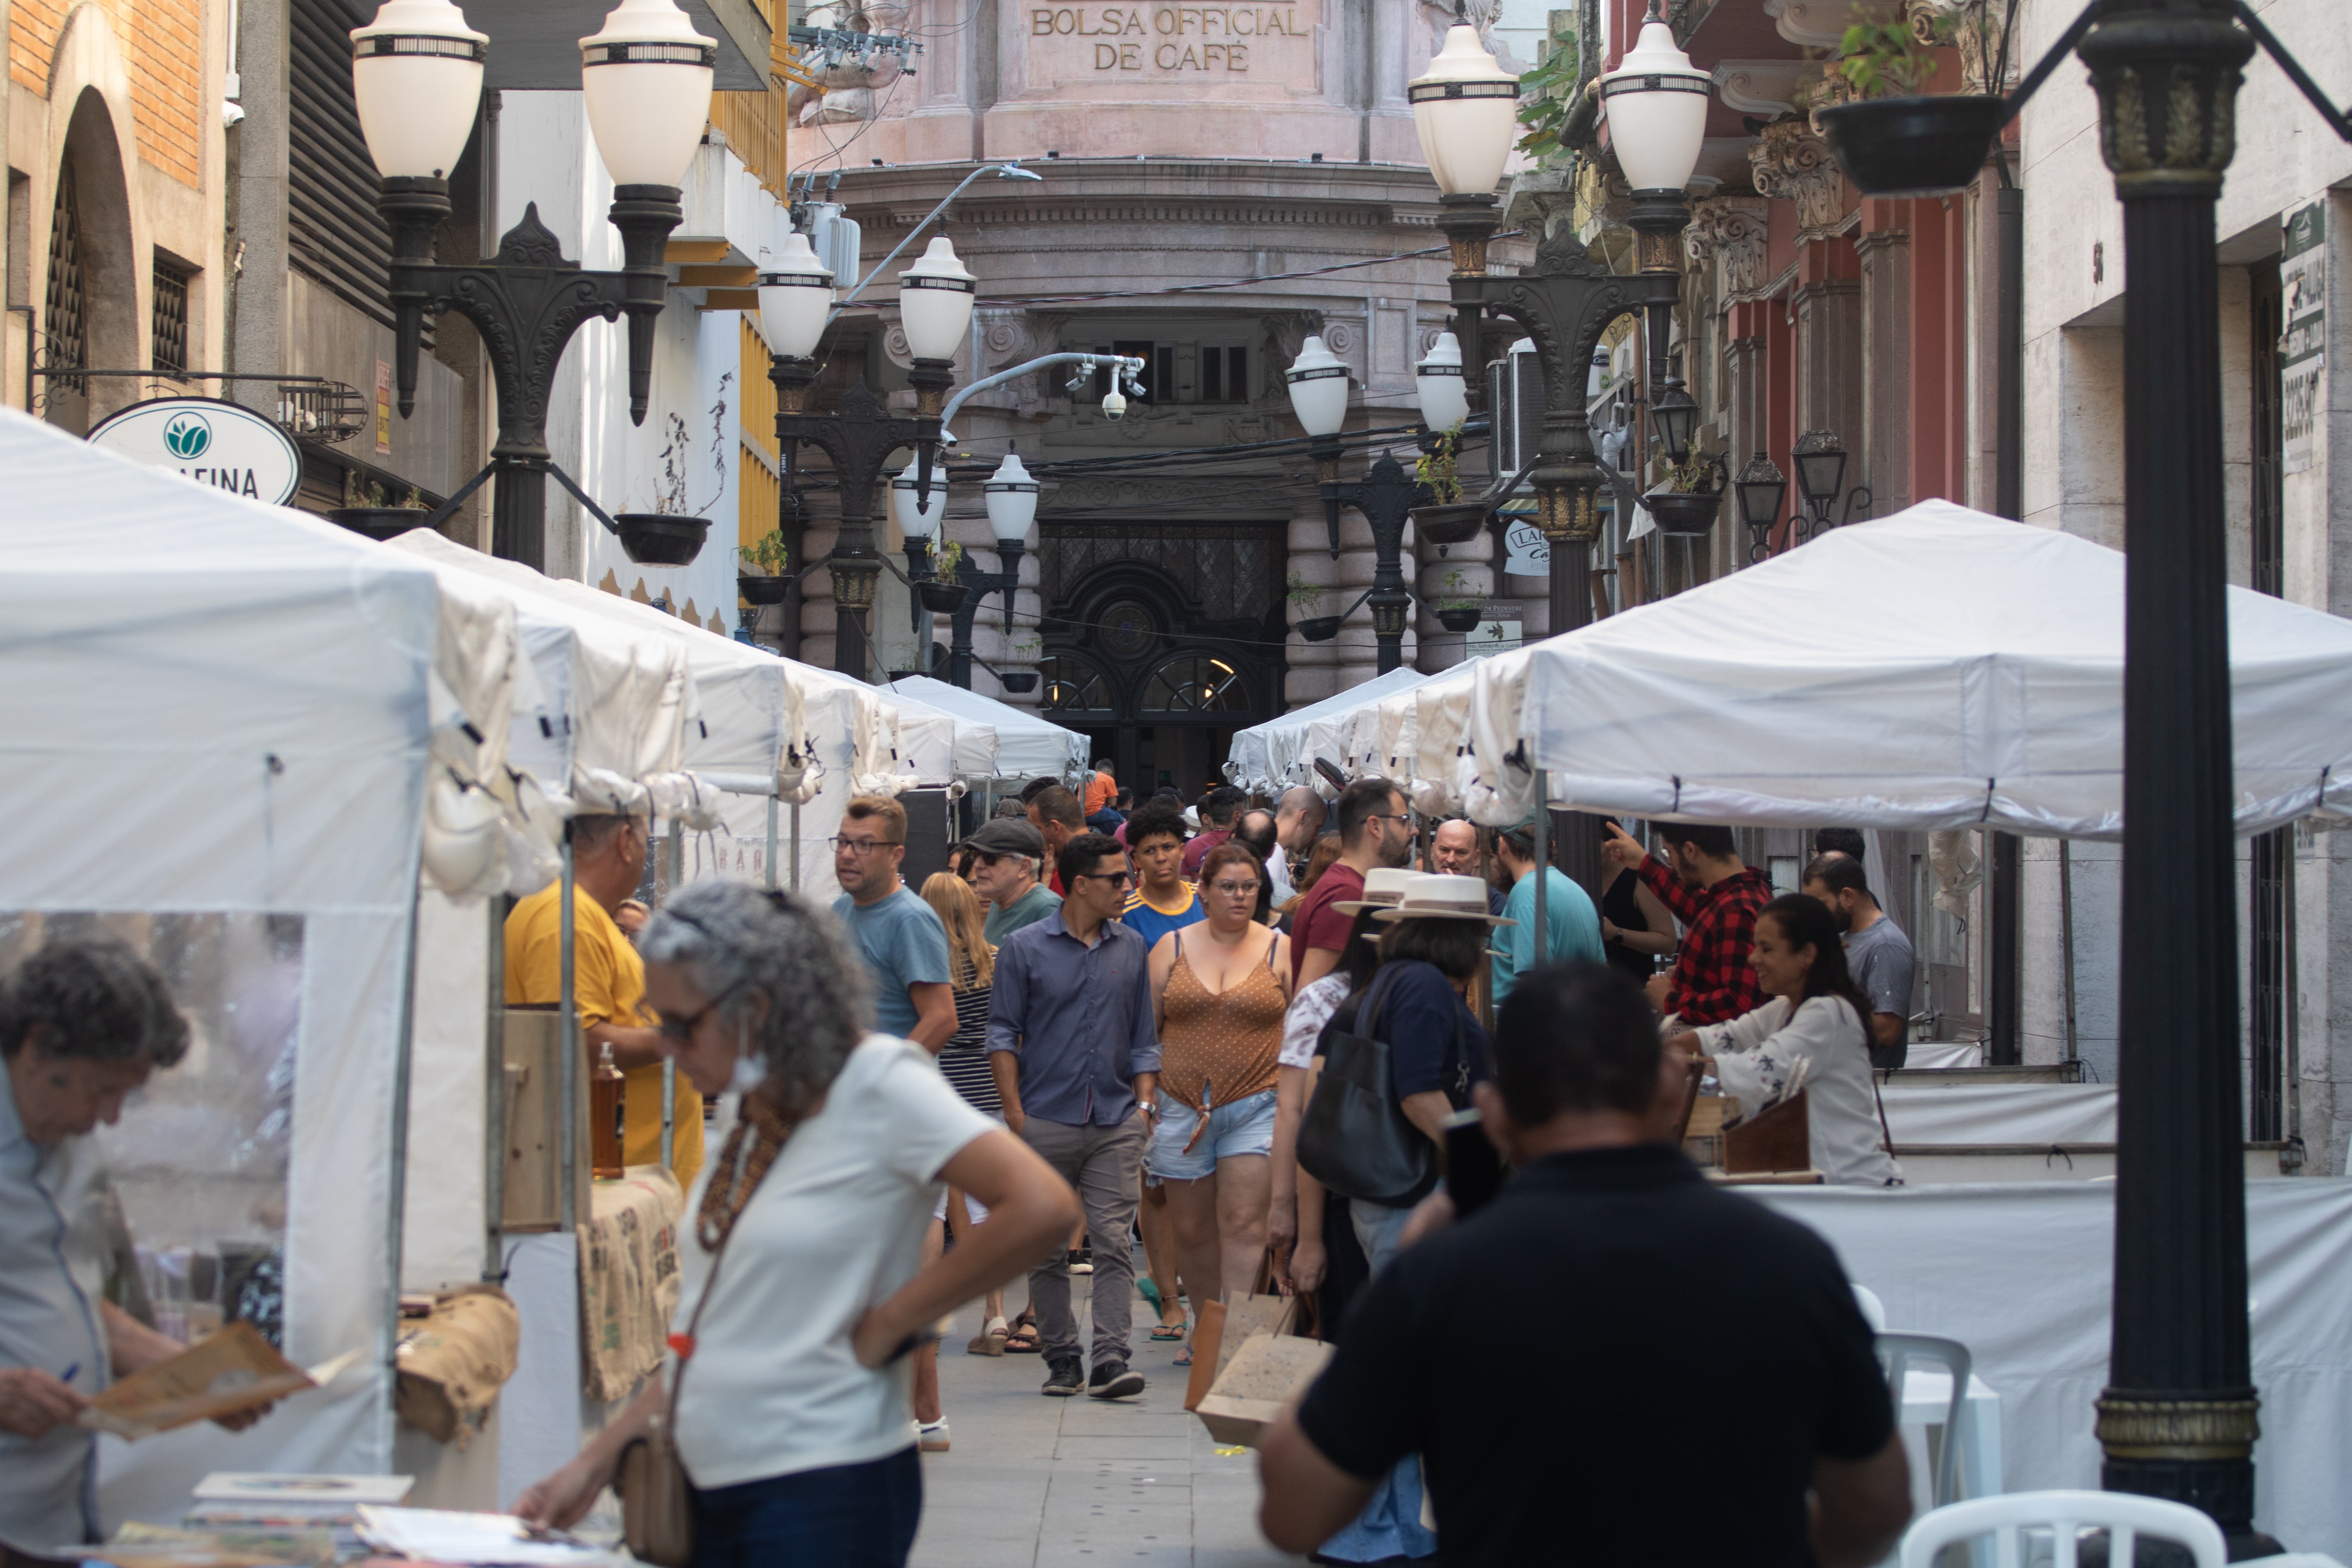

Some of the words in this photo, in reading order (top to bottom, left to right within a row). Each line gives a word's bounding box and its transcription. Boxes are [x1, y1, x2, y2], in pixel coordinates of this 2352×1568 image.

[1032, 9, 1147, 36] BOLSA
[1155, 9, 1309, 36] OFFICIAL
[1094, 43, 1142, 70] DE
[1155, 40, 1249, 71] CAFÉ
